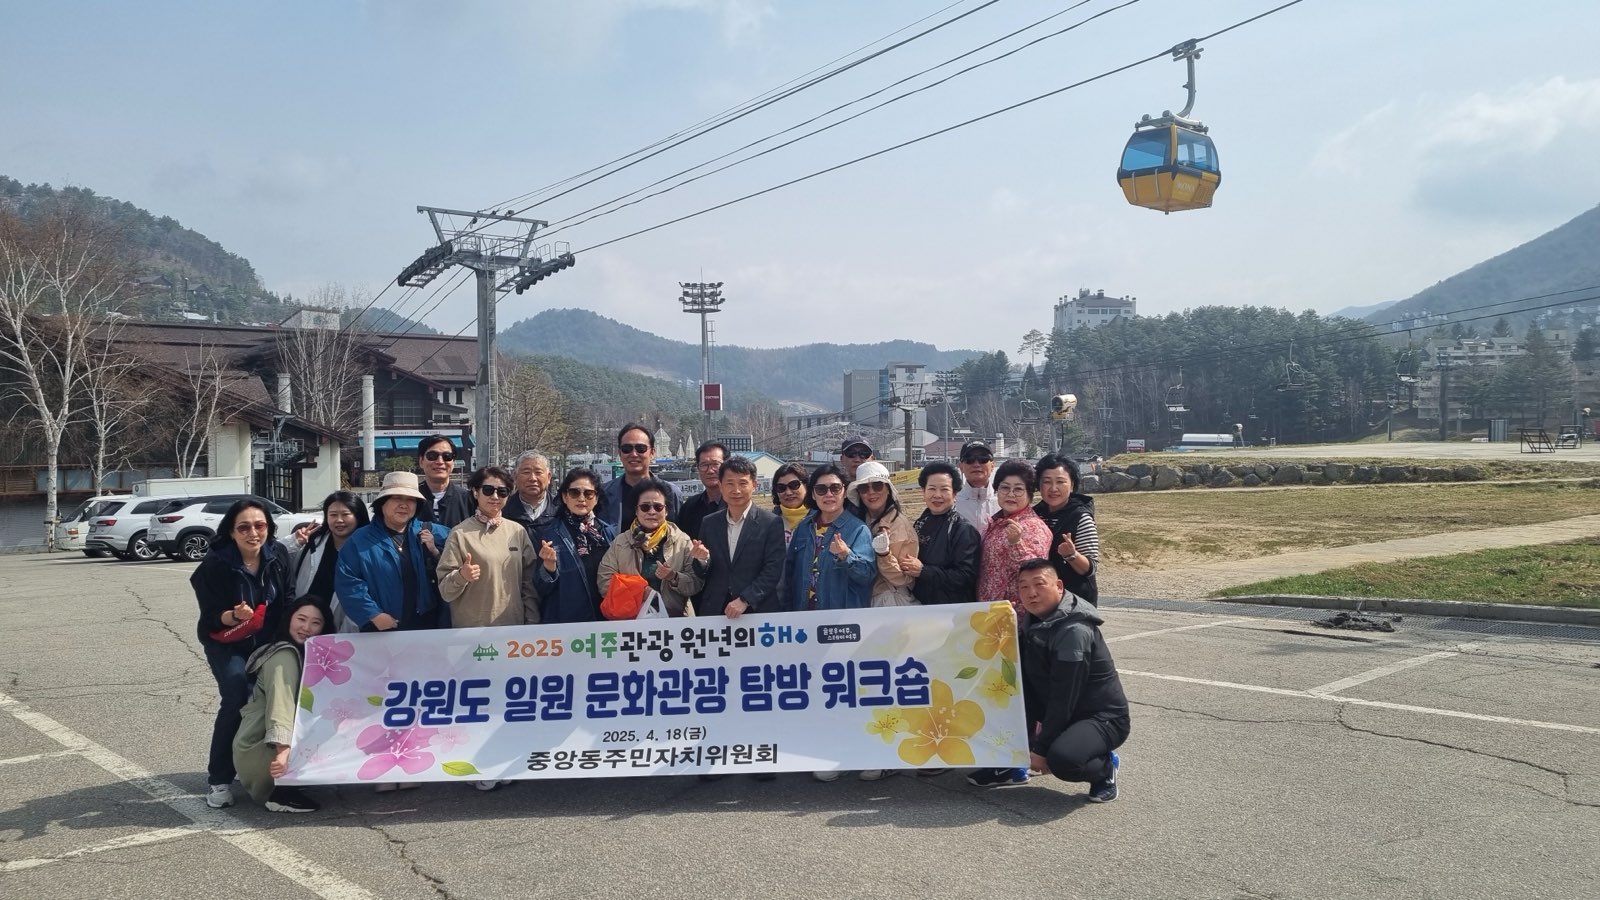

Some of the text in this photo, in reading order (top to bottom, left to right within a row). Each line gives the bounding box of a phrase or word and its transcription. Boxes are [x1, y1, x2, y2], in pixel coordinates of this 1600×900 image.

[507, 639, 563, 658] 2025
[383, 656, 931, 727] 강원도 일원 문화관광 탐방 워크숍
[602, 725, 707, 743] 2025. 4. 18(금)
[526, 743, 779, 771] 중앙동주민자치위원회
